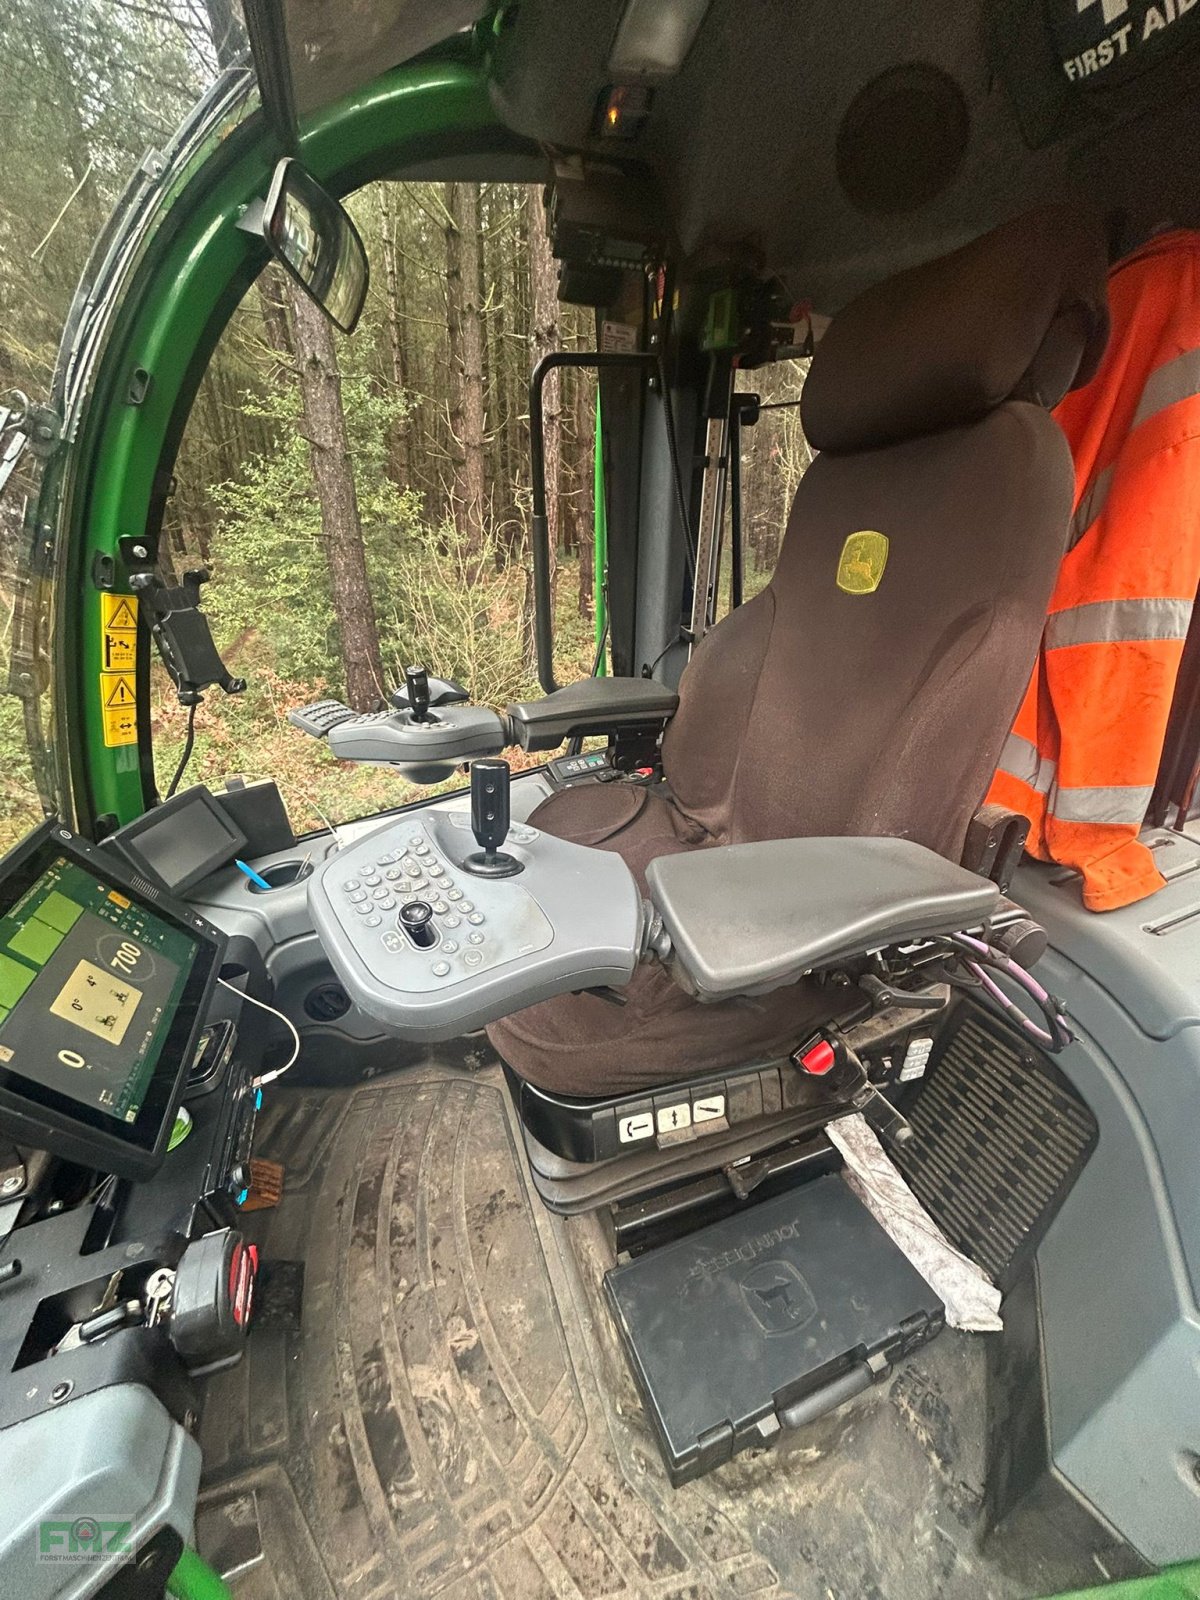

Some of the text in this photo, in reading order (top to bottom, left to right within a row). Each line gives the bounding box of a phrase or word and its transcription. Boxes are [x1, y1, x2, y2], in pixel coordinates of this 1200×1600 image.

[1062, 22, 1132, 82] FIRST
[110, 942, 141, 974] 700
[86, 975, 97, 987] 4°
[71, 998, 83, 1011] 0°
[57, 1049, 85, 1069] 0
